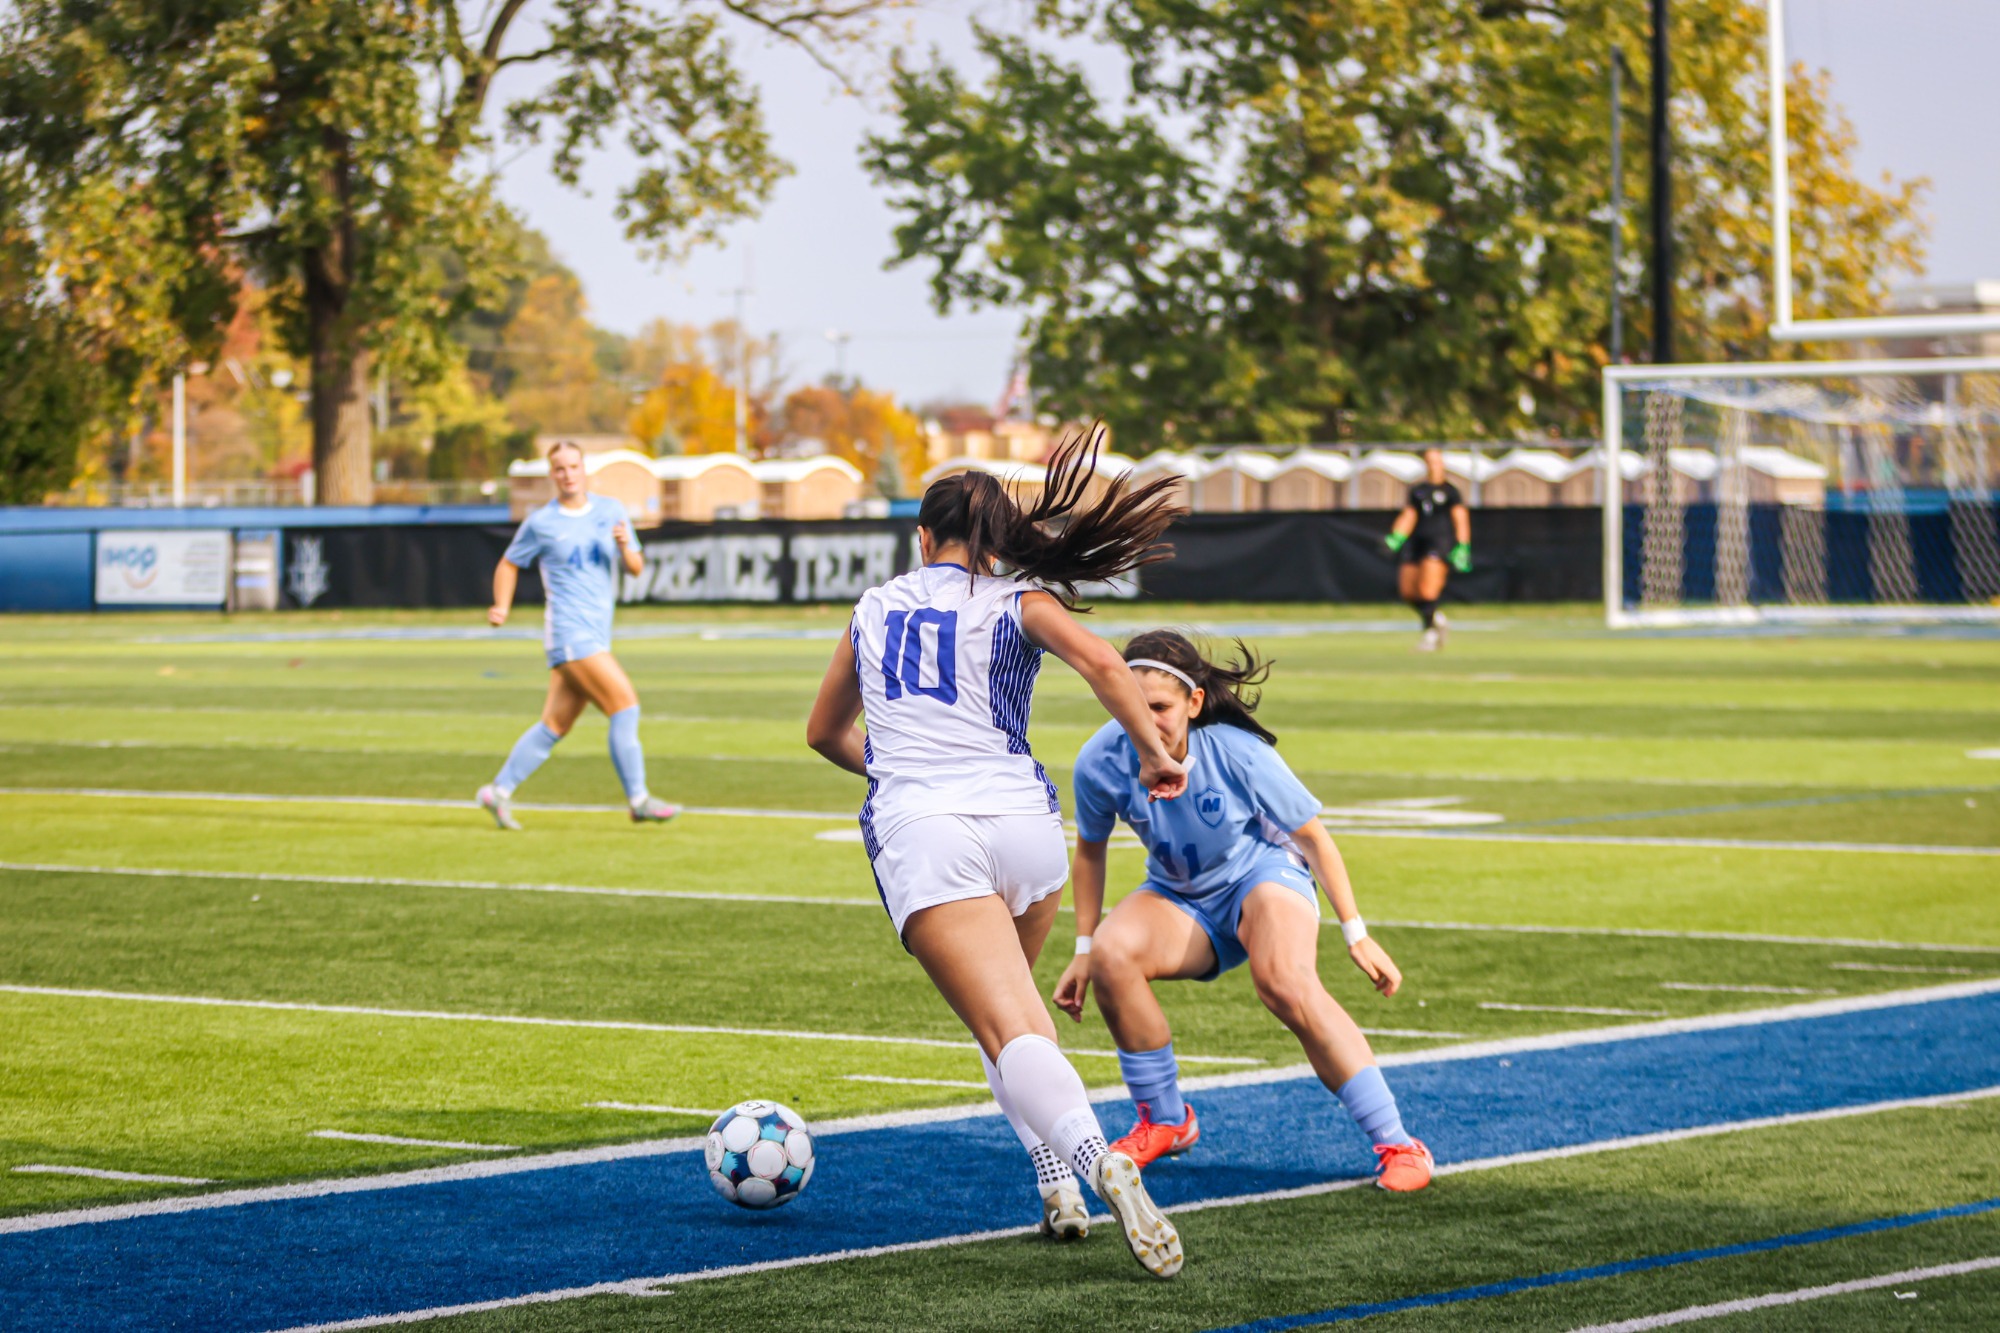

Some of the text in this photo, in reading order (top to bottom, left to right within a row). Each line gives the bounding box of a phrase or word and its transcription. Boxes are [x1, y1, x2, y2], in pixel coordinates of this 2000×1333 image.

[790, 533, 897, 600] TECH
[881, 607, 958, 706] 10
[1201, 797, 1221, 813] M
